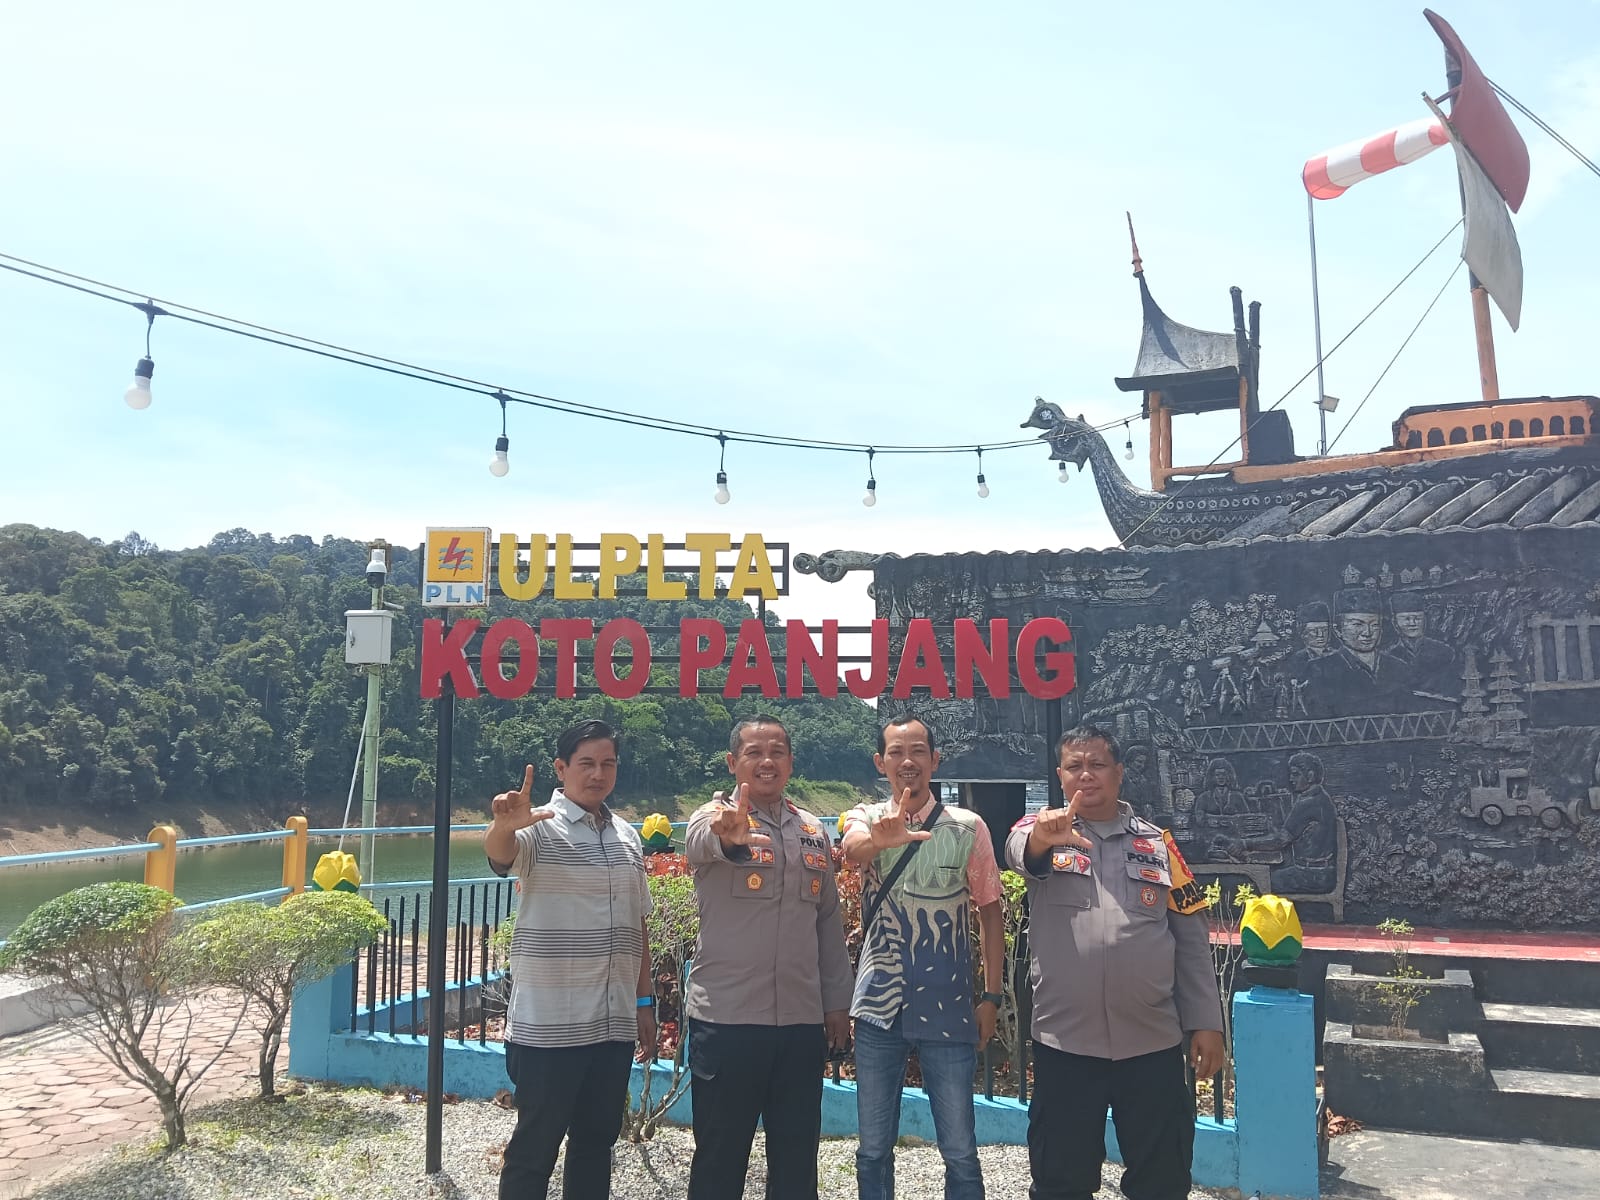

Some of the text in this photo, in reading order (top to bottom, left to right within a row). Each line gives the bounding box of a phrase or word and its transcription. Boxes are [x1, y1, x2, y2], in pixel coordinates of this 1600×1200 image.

[498, 533, 779, 600] ULPLTA
[425, 585, 484, 603] PLN
[420, 617, 1077, 699] KOTO PANJANG
[800, 837, 824, 849] POLRI
[1127, 852, 1166, 869] POLRI
